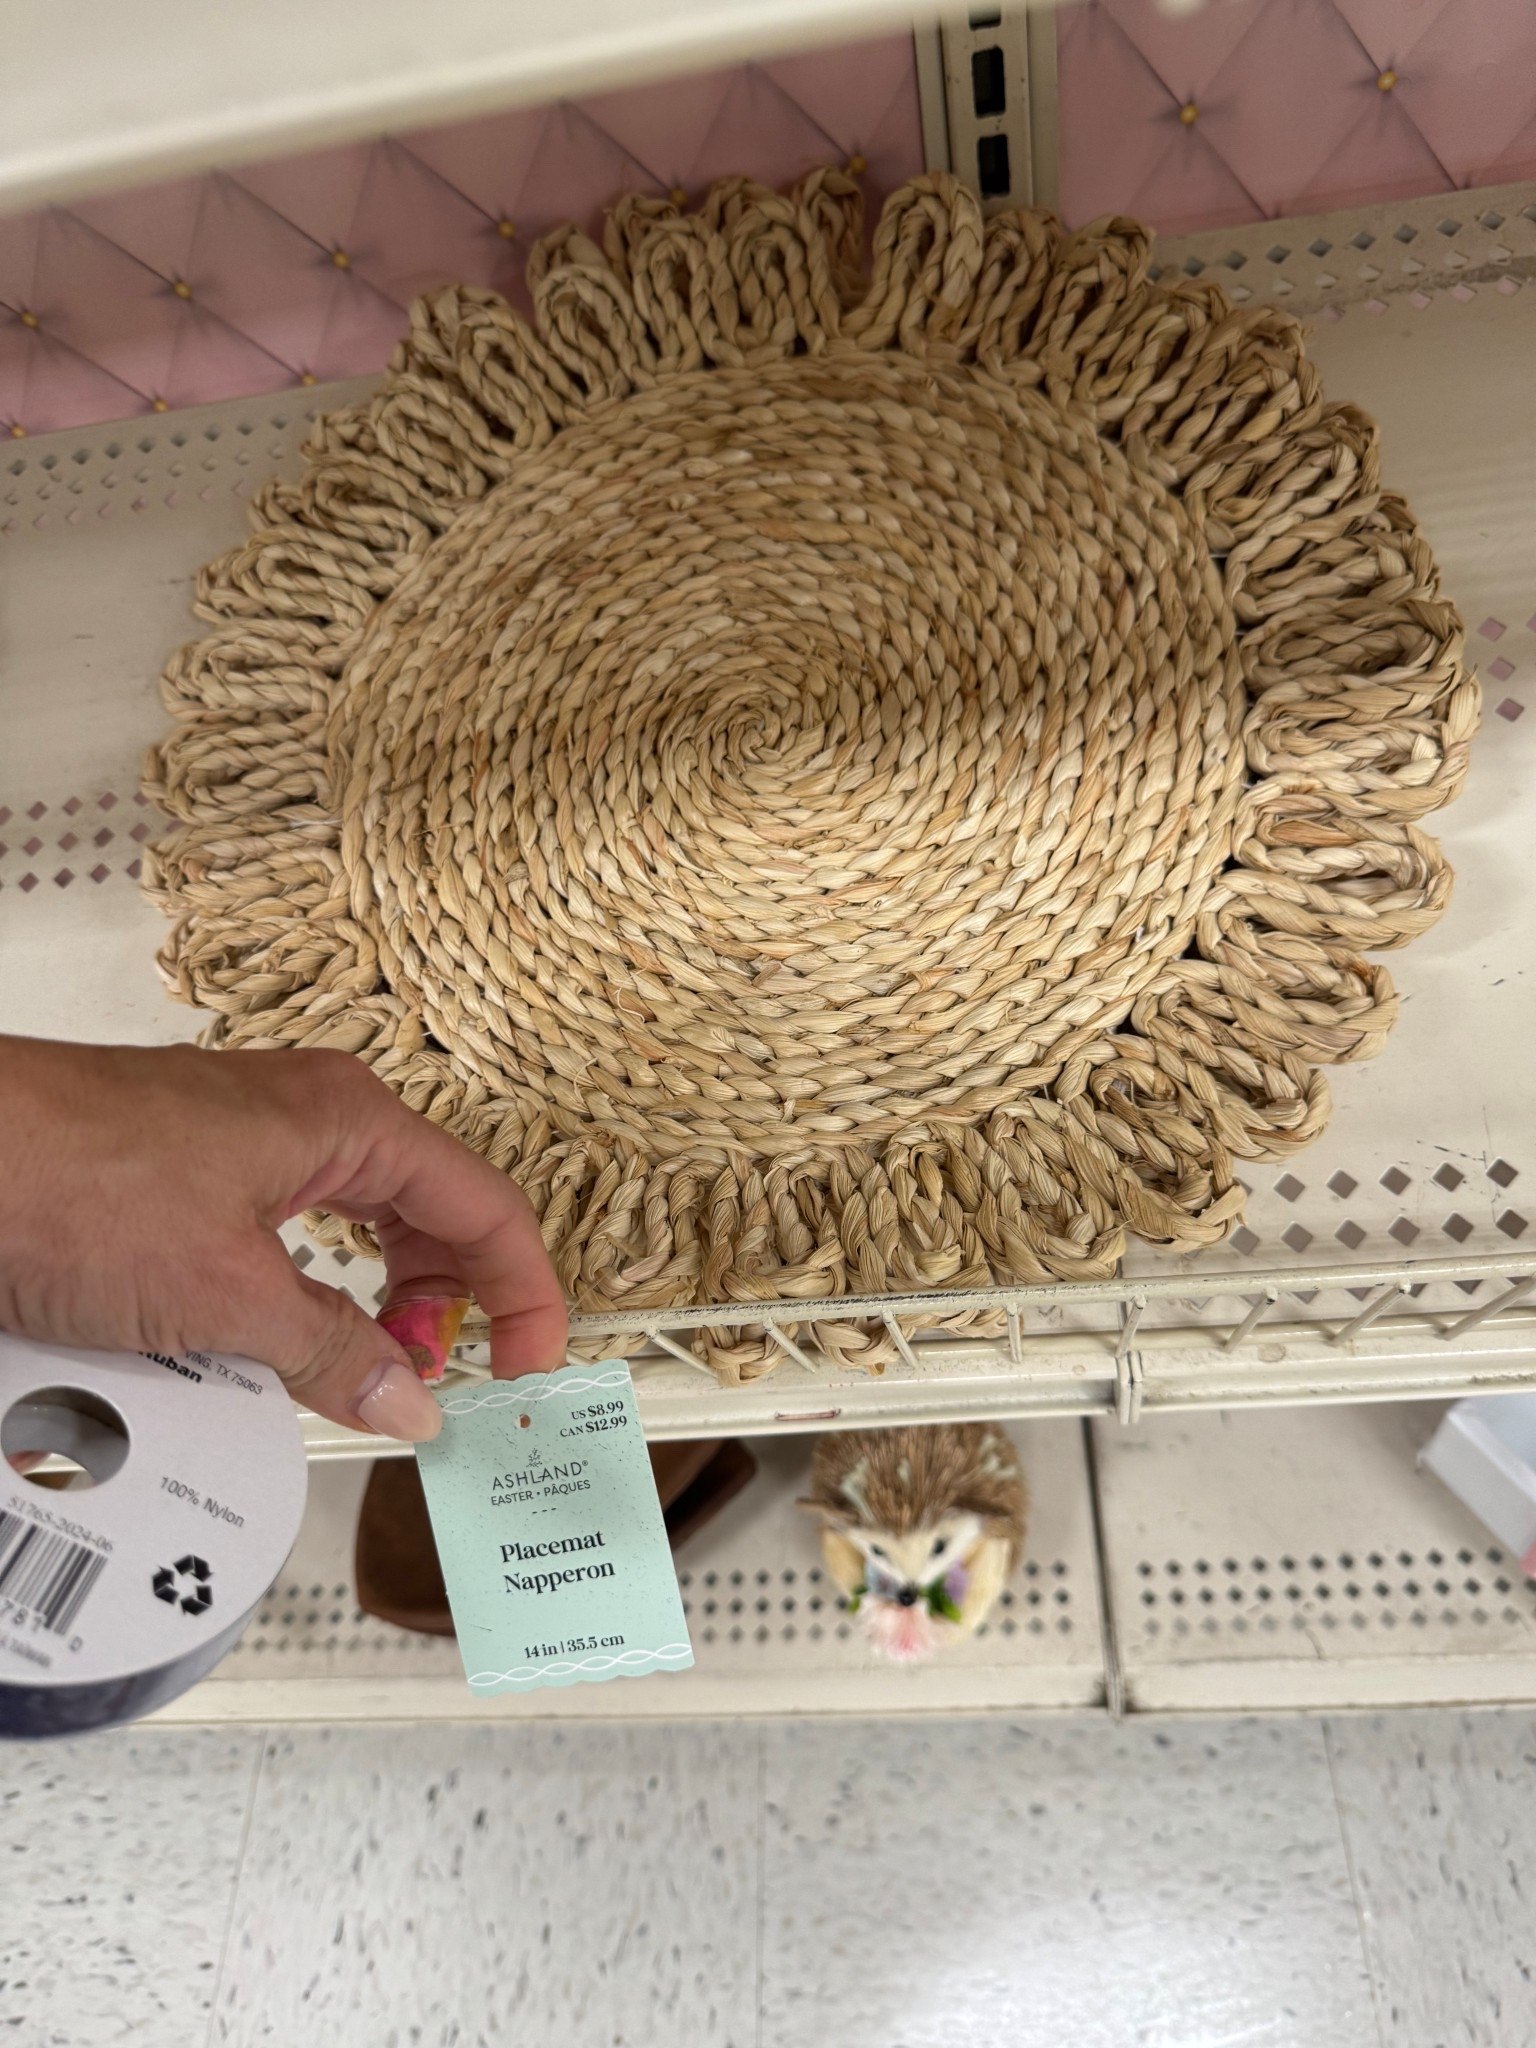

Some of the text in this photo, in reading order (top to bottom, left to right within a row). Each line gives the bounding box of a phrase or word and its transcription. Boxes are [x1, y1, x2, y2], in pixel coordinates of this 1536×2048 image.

[138, 1351, 203, 1383] uban
[215, 1363, 232, 1379] TX
[231, 1372, 263, 1395] 75063
[570, 1400, 624, 1420] US $8.99
[559, 1415, 628, 1438] CAN $12.99
[160, 1476, 245, 1528] 100% Nylon
[490, 1490, 535, 1506] EASTER
[543, 1479, 591, 1497] PÂQUES
[500, 1530, 606, 1563] Placemat
[504, 1562, 616, 1594] Napperon
[524, 1645, 540, 1659] 14
[542, 1643, 558, 1656] in
[566, 1636, 598, 1652] 35.5
[600, 1634, 625, 1647] cm
